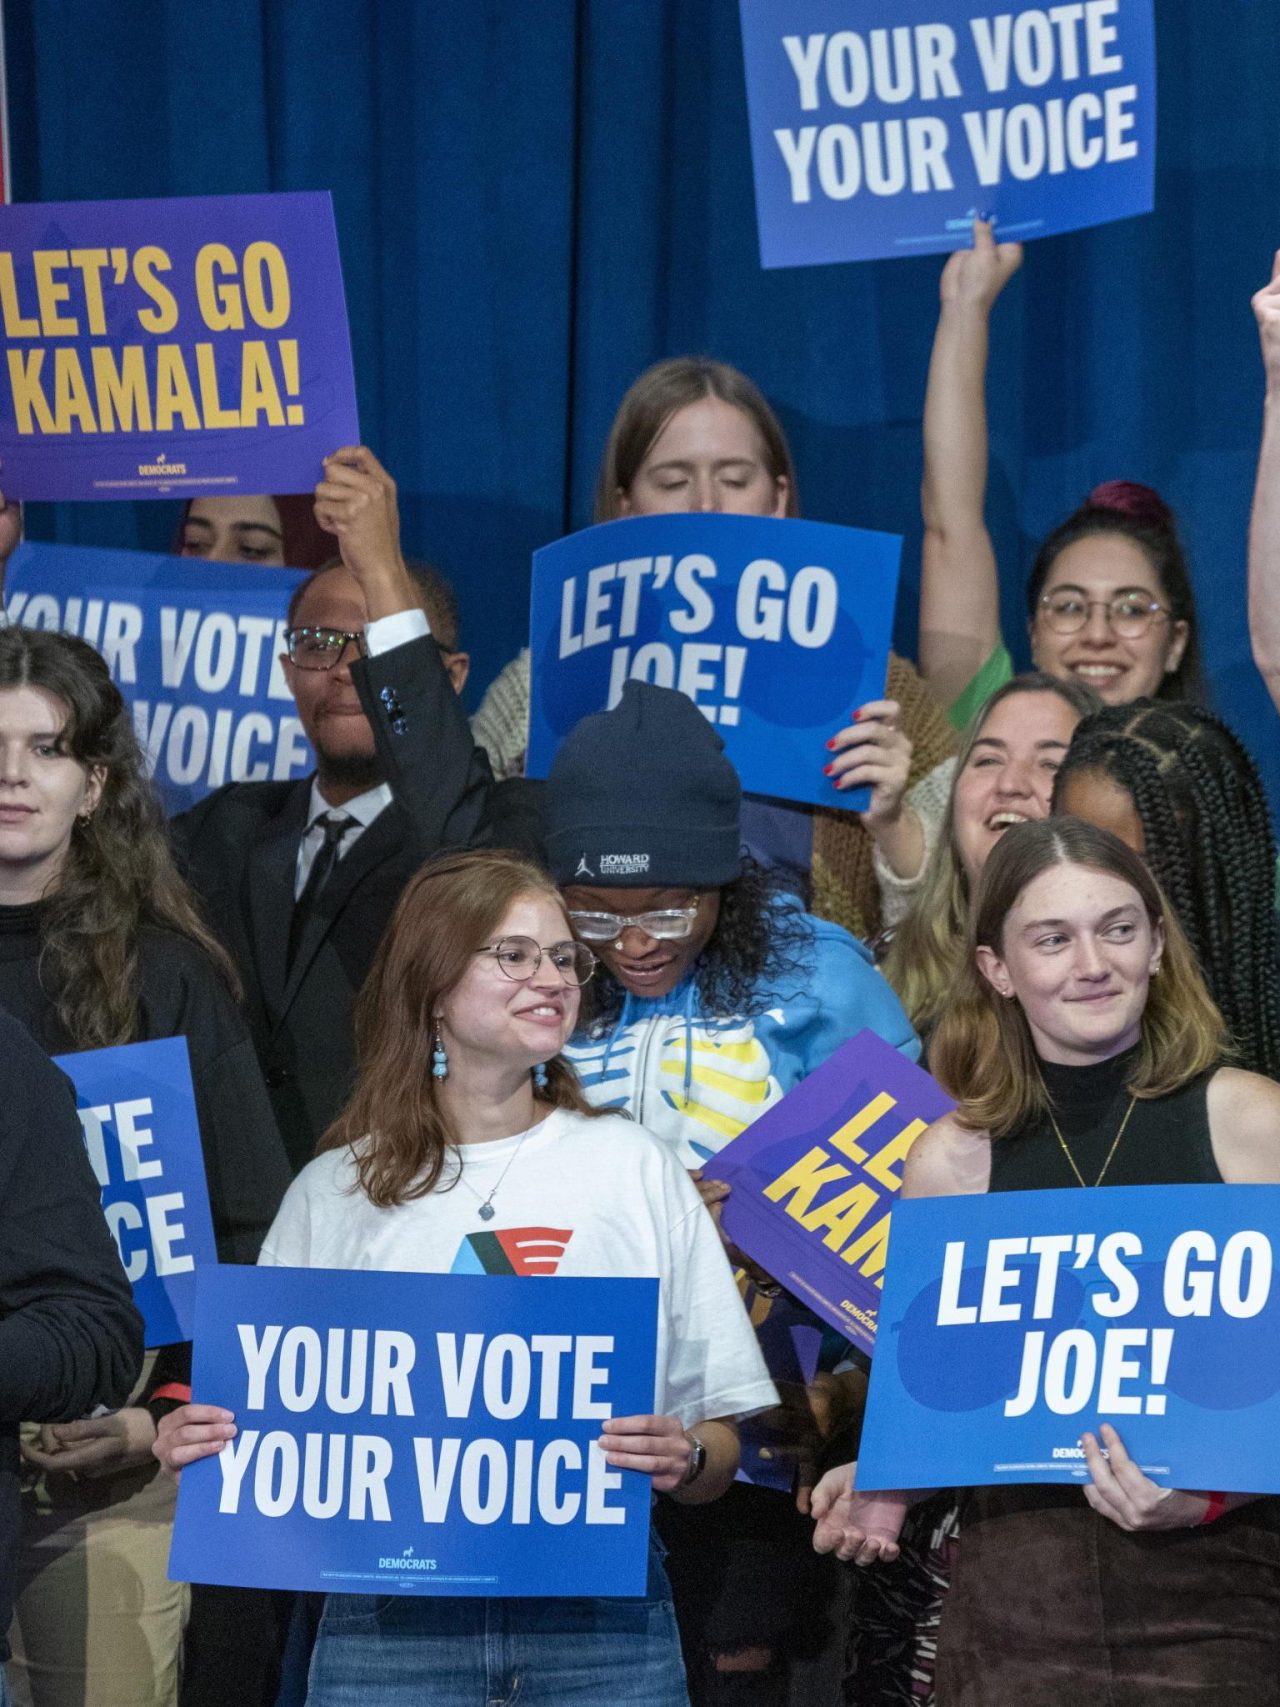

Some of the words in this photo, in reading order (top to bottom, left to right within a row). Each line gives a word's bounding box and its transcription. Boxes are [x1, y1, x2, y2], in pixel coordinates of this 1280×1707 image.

[783, 23, 962, 111] YOUR
[971, 0, 1123, 92] VOTE
[774, 116, 954, 203] YOUR
[962, 85, 1139, 186] VOICE
[0, 246, 179, 336] LET'S
[195, 241, 290, 331] GO
[6, 340, 304, 435] KAMALA!
[160, 607, 295, 700] VOTE
[559, 553, 717, 660] LET'S
[736, 559, 838, 648] GO
[133, 699, 308, 787] VOICE
[600, 854, 650, 864] HOWARD
[600, 865, 650, 874] UNIVERSITY
[936, 1232, 1142, 1327] LET'S
[1163, 1230, 1272, 1318] GO
[237, 1324, 416, 1417] YOUR
[436, 1332, 614, 1420] VOTE
[1004, 1328, 1173, 1417] JOE!
[219, 1428, 394, 1521] YOUR
[414, 1438, 625, 1525] VOICE
[379, 1558, 436, 1569] DEMOCRATS
